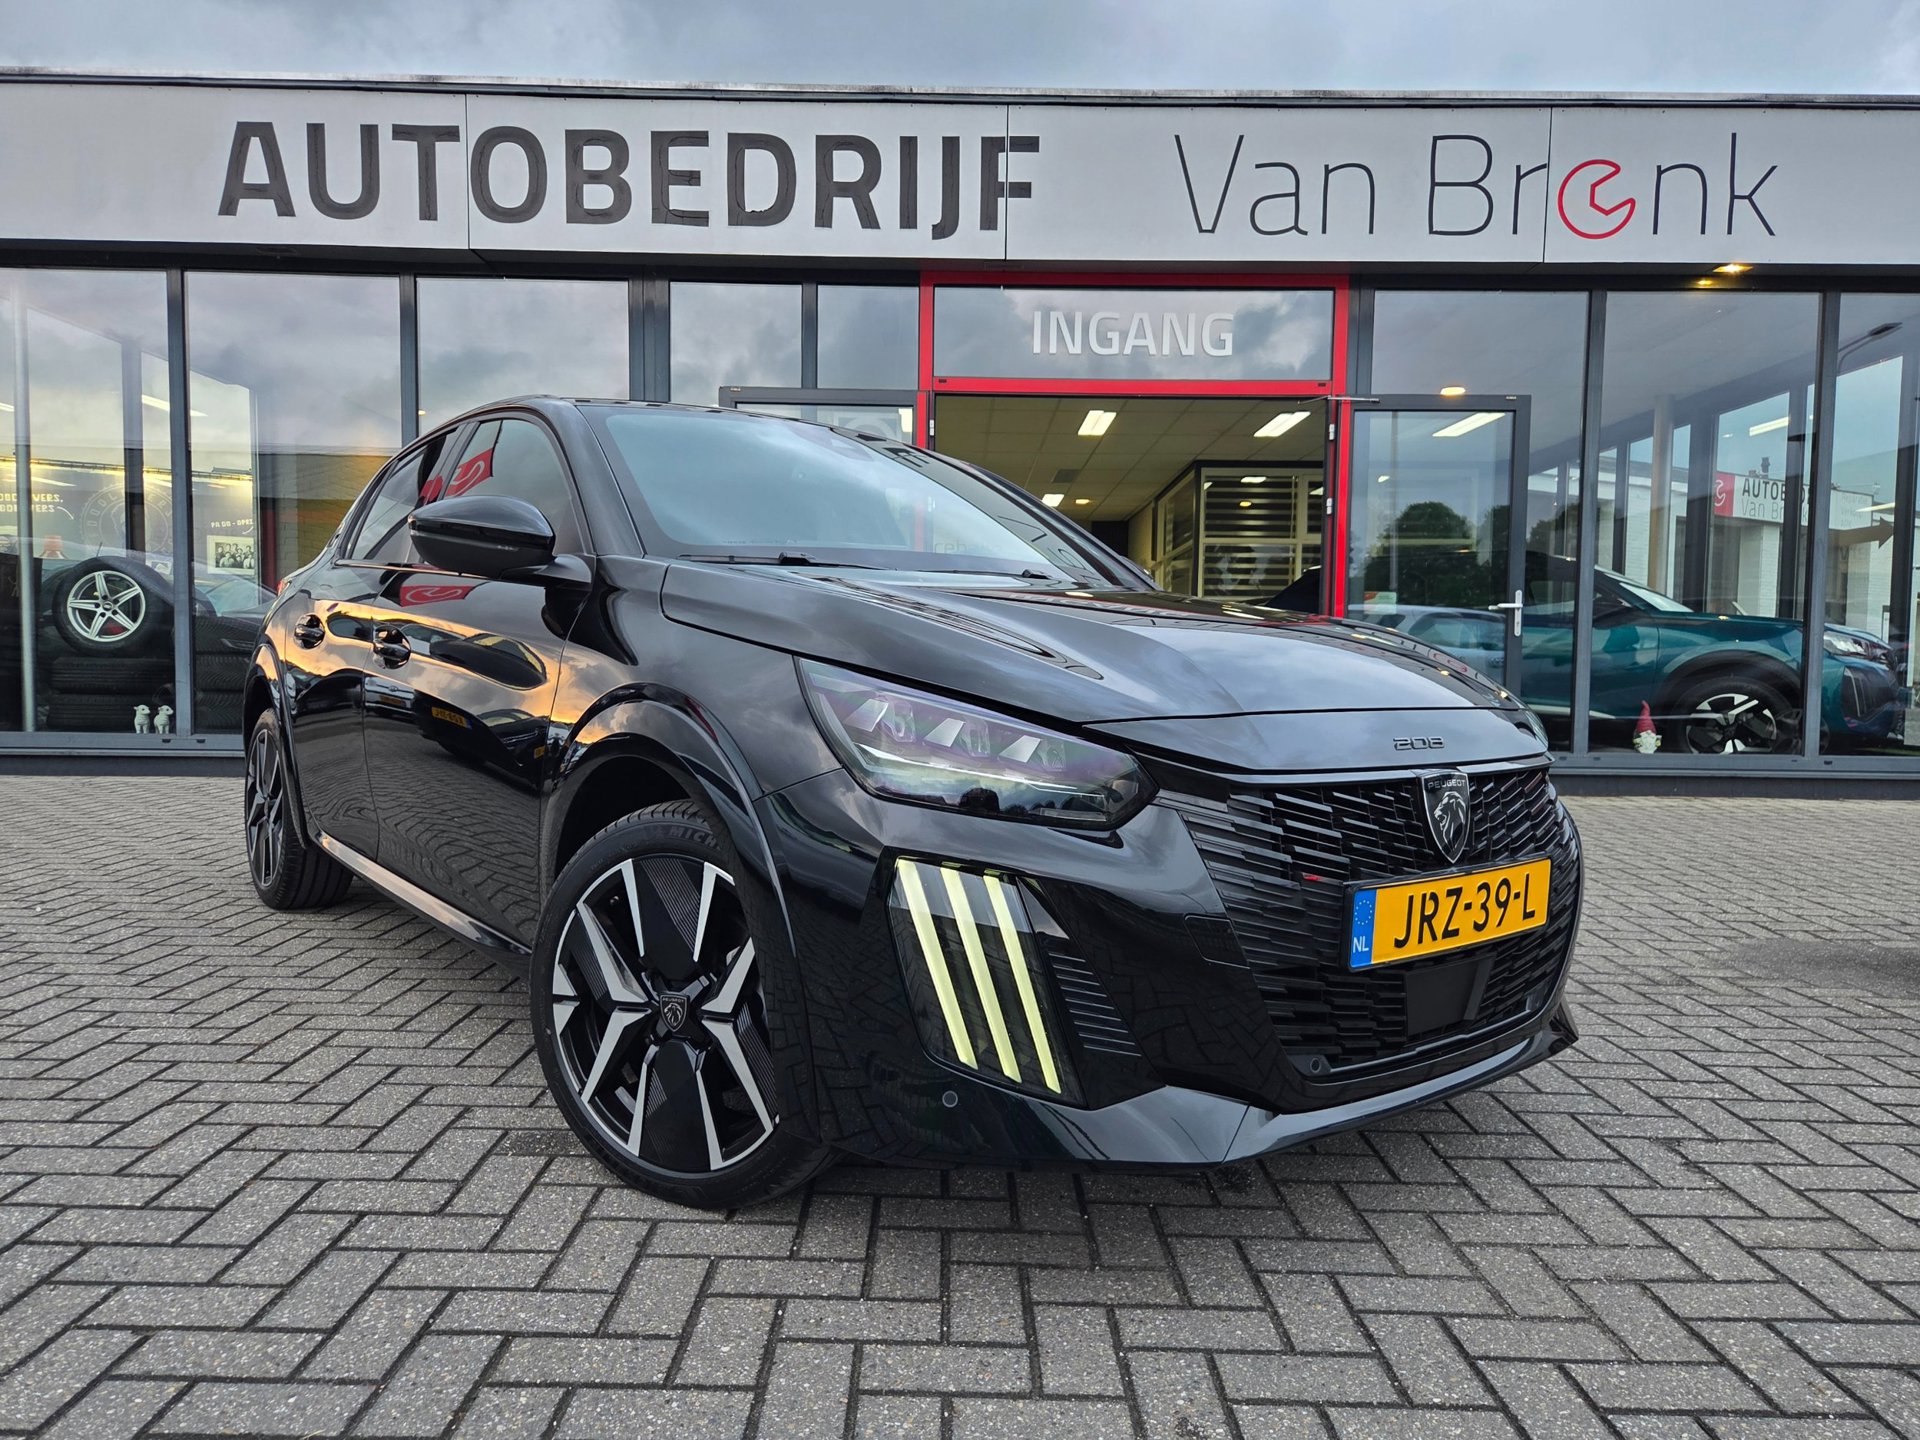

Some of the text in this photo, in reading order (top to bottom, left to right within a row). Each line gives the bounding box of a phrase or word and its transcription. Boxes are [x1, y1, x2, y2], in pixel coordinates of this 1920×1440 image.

[217, 121, 1040, 241] AUTOBEDRIJF
[1174, 134, 1375, 236] Van
[1032, 310, 1235, 357] INGANG
[1741, 498, 1766, 518] Van
[1392, 736, 1445, 751] 208
[1427, 778, 1466, 790] PEUGEOT
[666, 825, 719, 850] MICH
[1394, 873, 1536, 949] JRZ-39-L
[1352, 935, 1370, 953] NL
